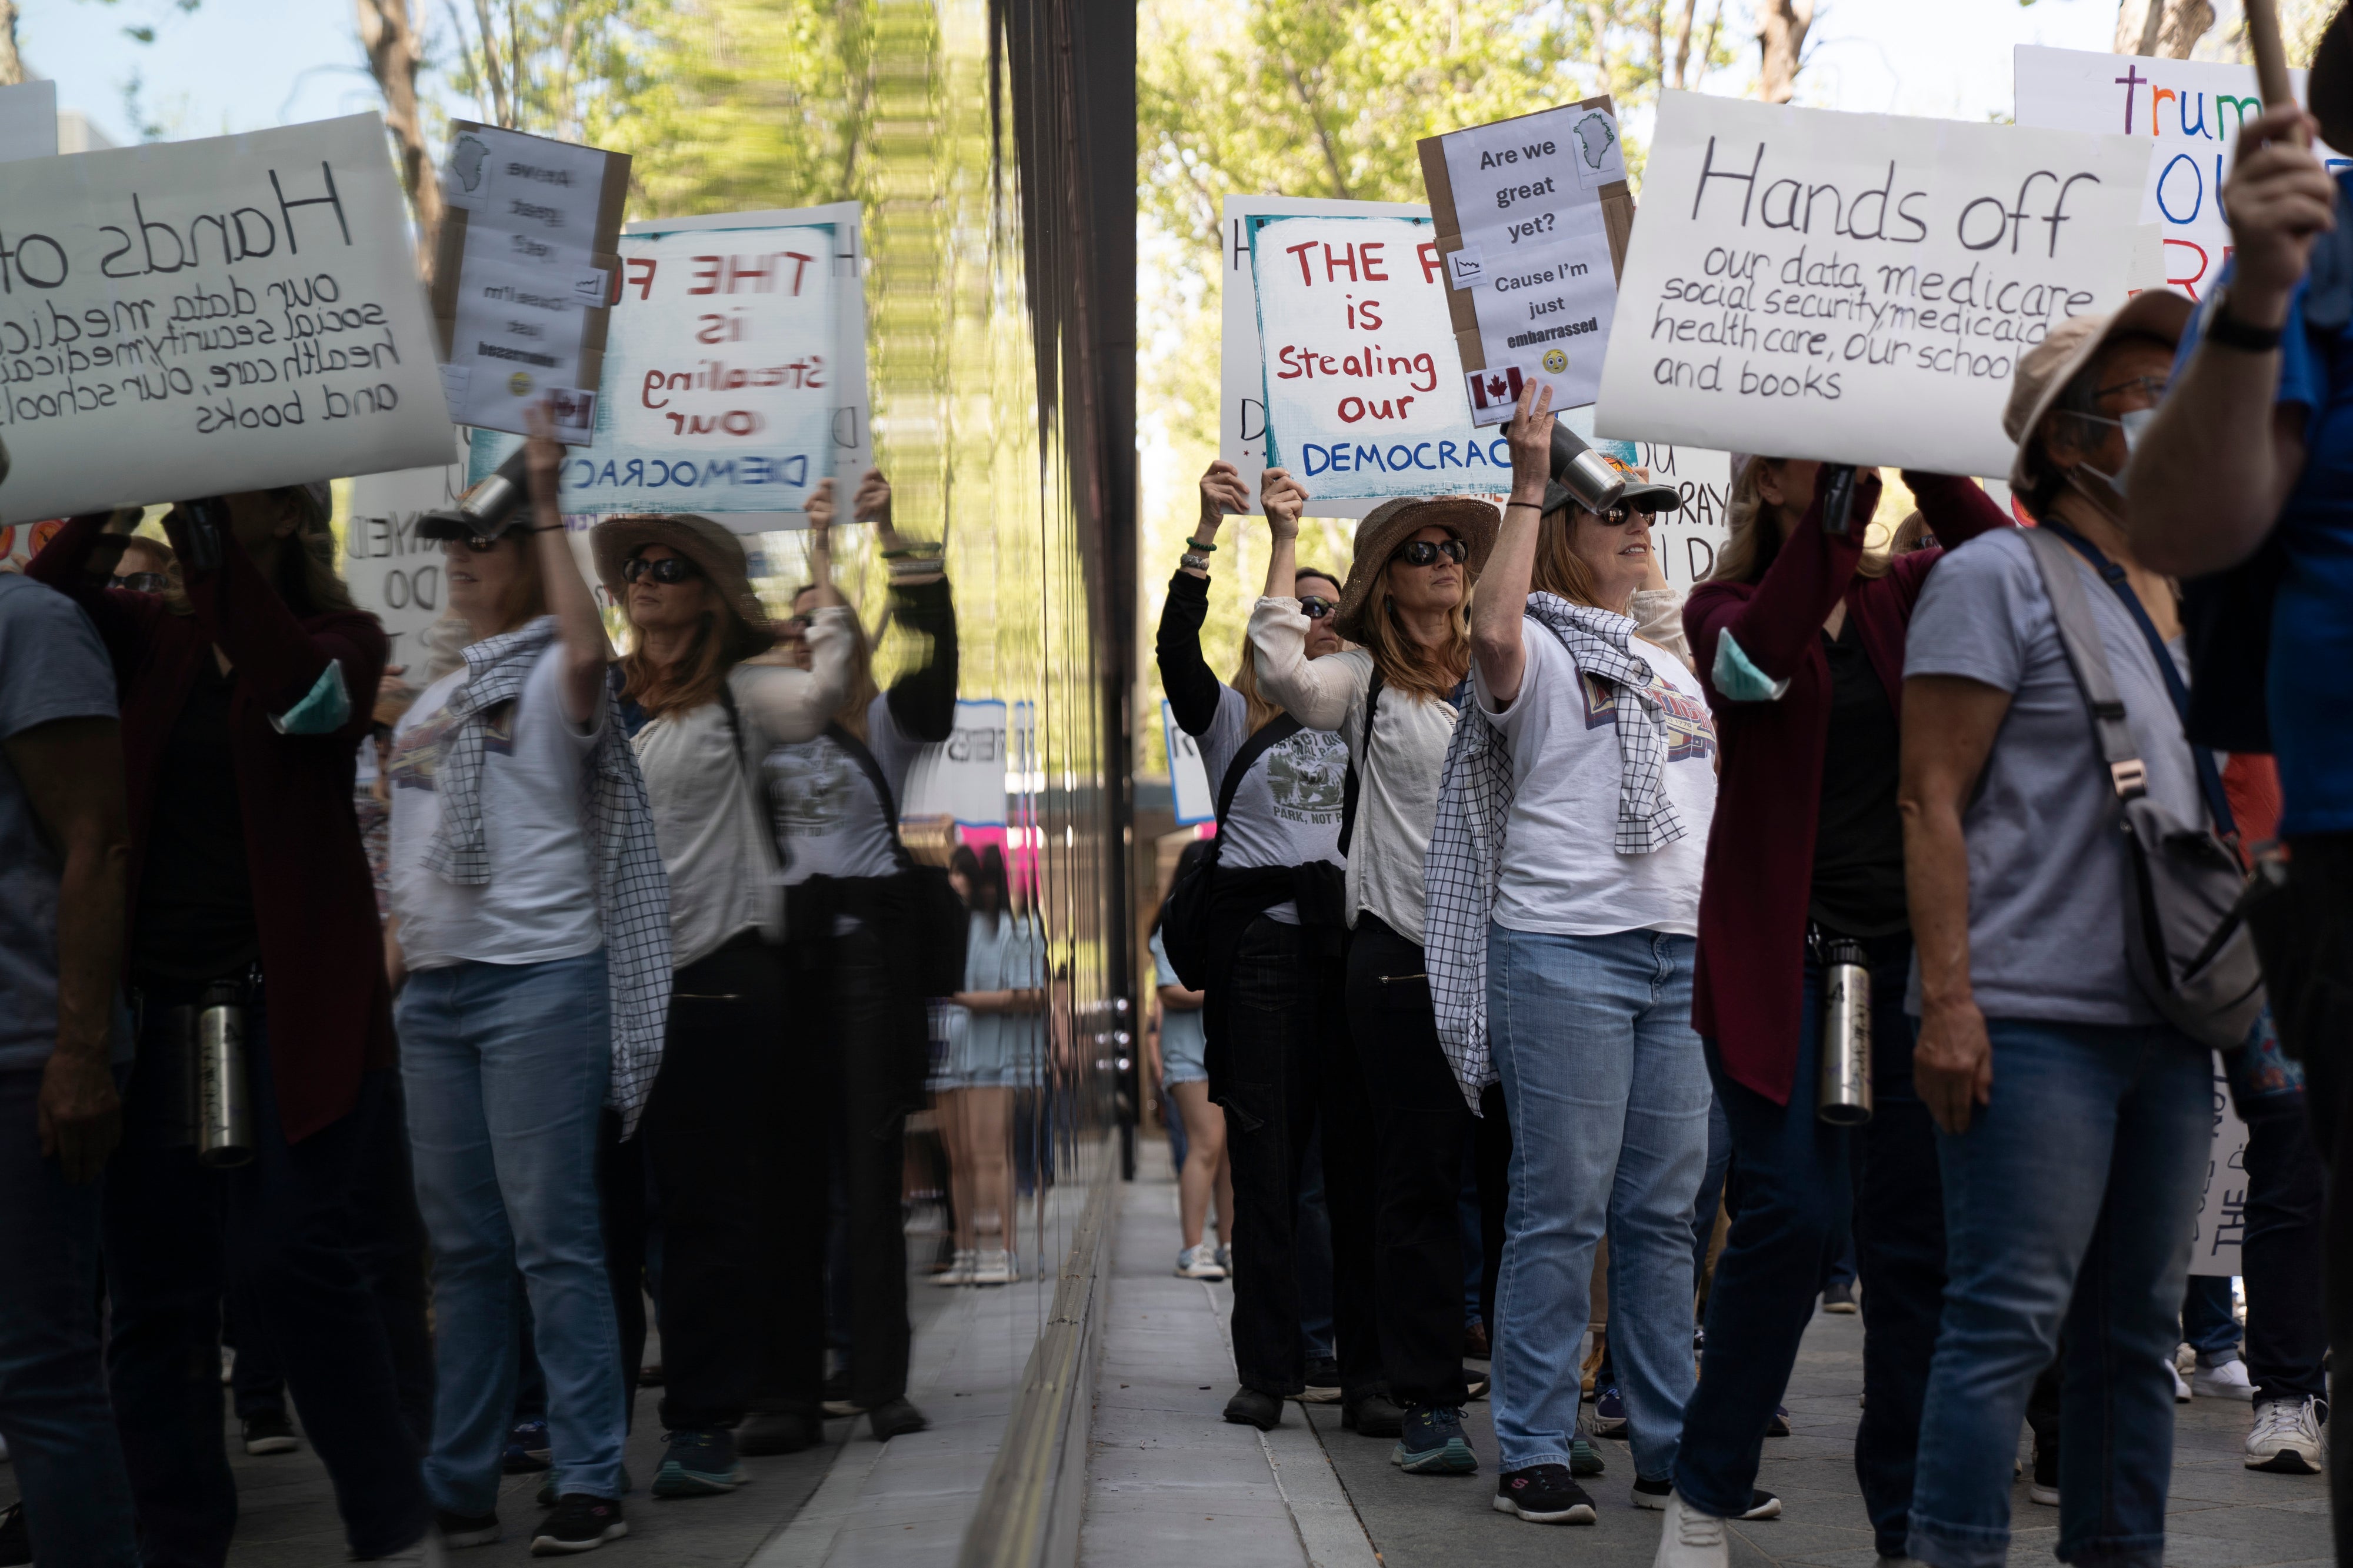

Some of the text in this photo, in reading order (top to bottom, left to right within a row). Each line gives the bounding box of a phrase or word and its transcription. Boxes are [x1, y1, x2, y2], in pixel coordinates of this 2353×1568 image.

[2115, 64, 2264, 141] trum
[1479, 139, 1557, 171] Are we
[1495, 178, 1556, 208] great
[1691, 135, 2101, 258] Hands off
[1507, 212, 1557, 244] yet?
[1286, 241, 1389, 287] THE
[1494, 260, 1589, 293] Cause I'm
[1661, 278, 1756, 312] social
[1704, 246, 1770, 281] our
[1877, 261, 2094, 318] medicare
[1347, 294, 1382, 331] is
[1528, 296, 1565, 320] just
[1506, 317, 1598, 349] embarrassed
[1277, 345, 1438, 392] Stealing
[1844, 333, 1911, 365] our
[1917, 337, 2020, 379] school
[1654, 356, 1841, 399] and books
[1302, 439, 1512, 477] DEMOCRAC
[1675, 719, 1692, 728] 1776
[1273, 805, 1308, 825] PARK,
[1311, 813, 1332, 825] NOT
